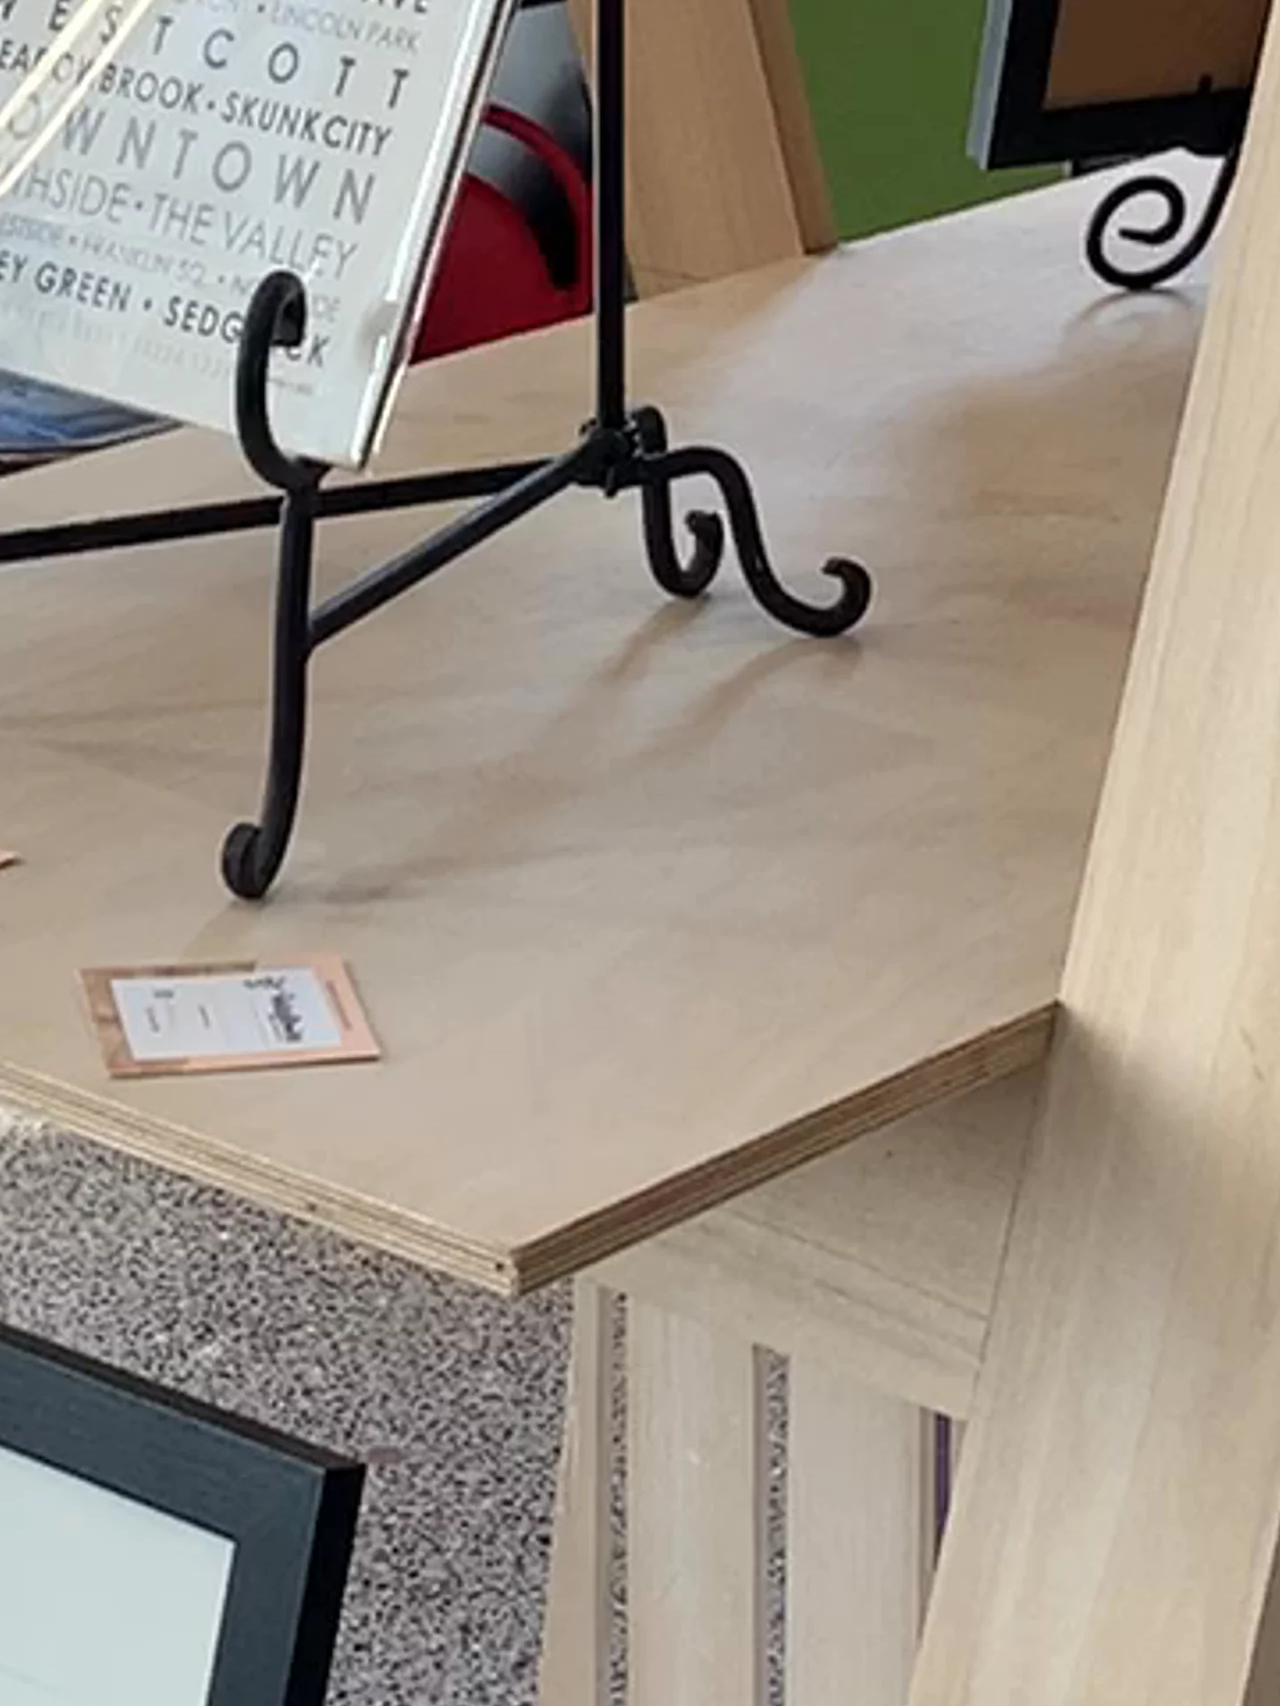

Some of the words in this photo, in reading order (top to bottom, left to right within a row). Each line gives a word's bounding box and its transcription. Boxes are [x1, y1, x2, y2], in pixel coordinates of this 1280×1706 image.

[365, 21, 419, 55] PARK
[221, 90, 322, 141] SKUNK
[322, 114, 393, 157] CITY
[149, 192, 215, 246] THE
[224, 210, 359, 279] VALLEY
[34, 260, 133, 312] GREEN
[162, 294, 331, 368] SEDGCK
